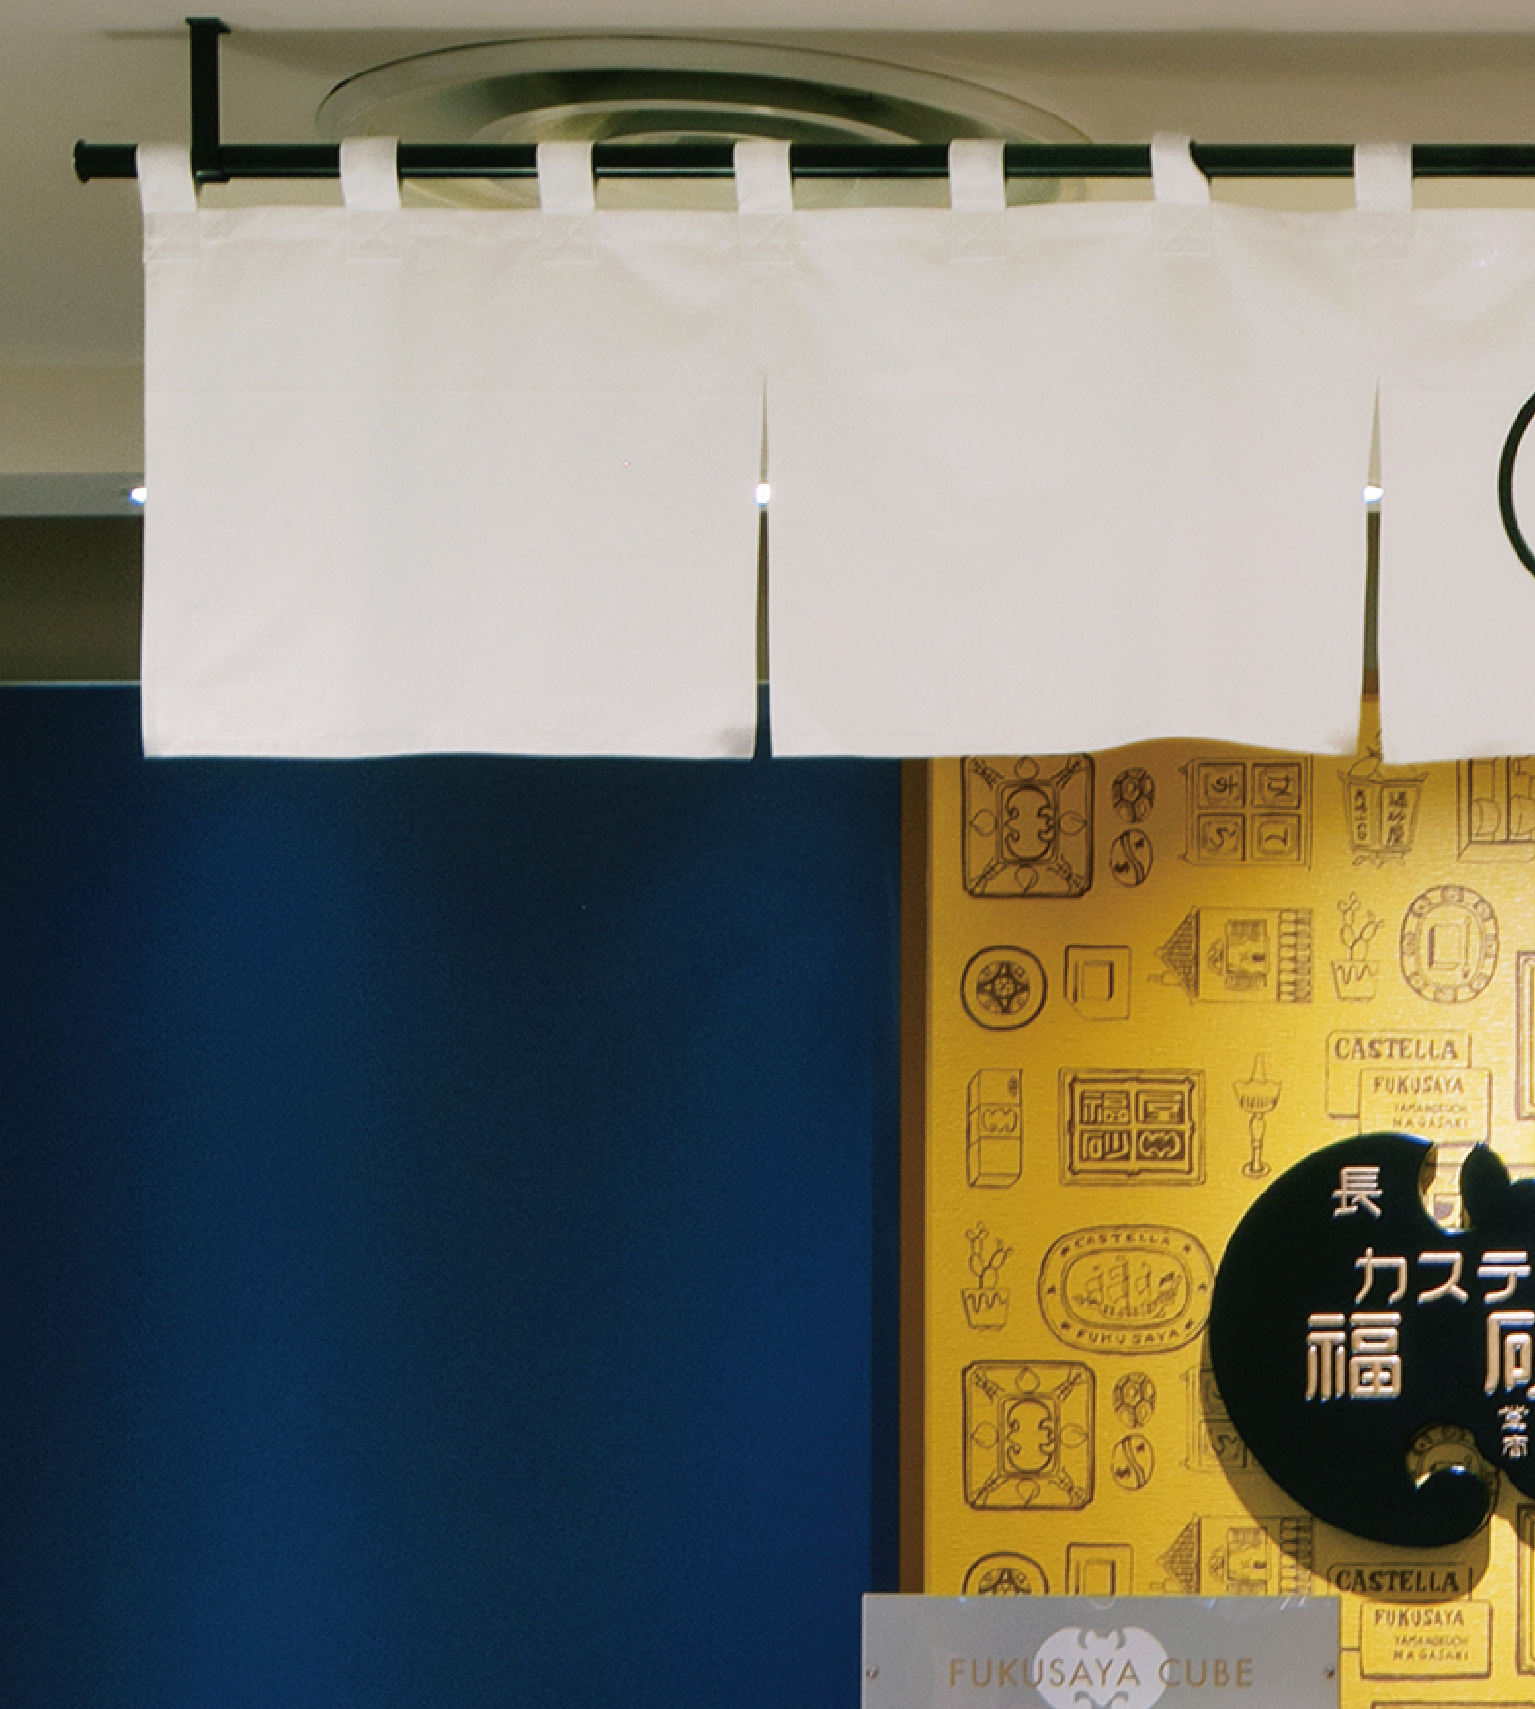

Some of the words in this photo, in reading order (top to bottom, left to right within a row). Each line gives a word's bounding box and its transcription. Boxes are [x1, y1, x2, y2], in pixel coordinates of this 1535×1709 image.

[1335, 1037, 1459, 1060] CASTELLA
[1373, 1076, 1465, 1094] FUKUSAYA
[1074, 1233, 1171, 1247] CASTELLA
[1335, 1568, 1460, 1592] CASTELLA
[1374, 1608, 1465, 1627] FUKUSAYA
[948, 1657, 1142, 1689] FUKUSAYA
[1158, 1657, 1254, 1689] CUBE
